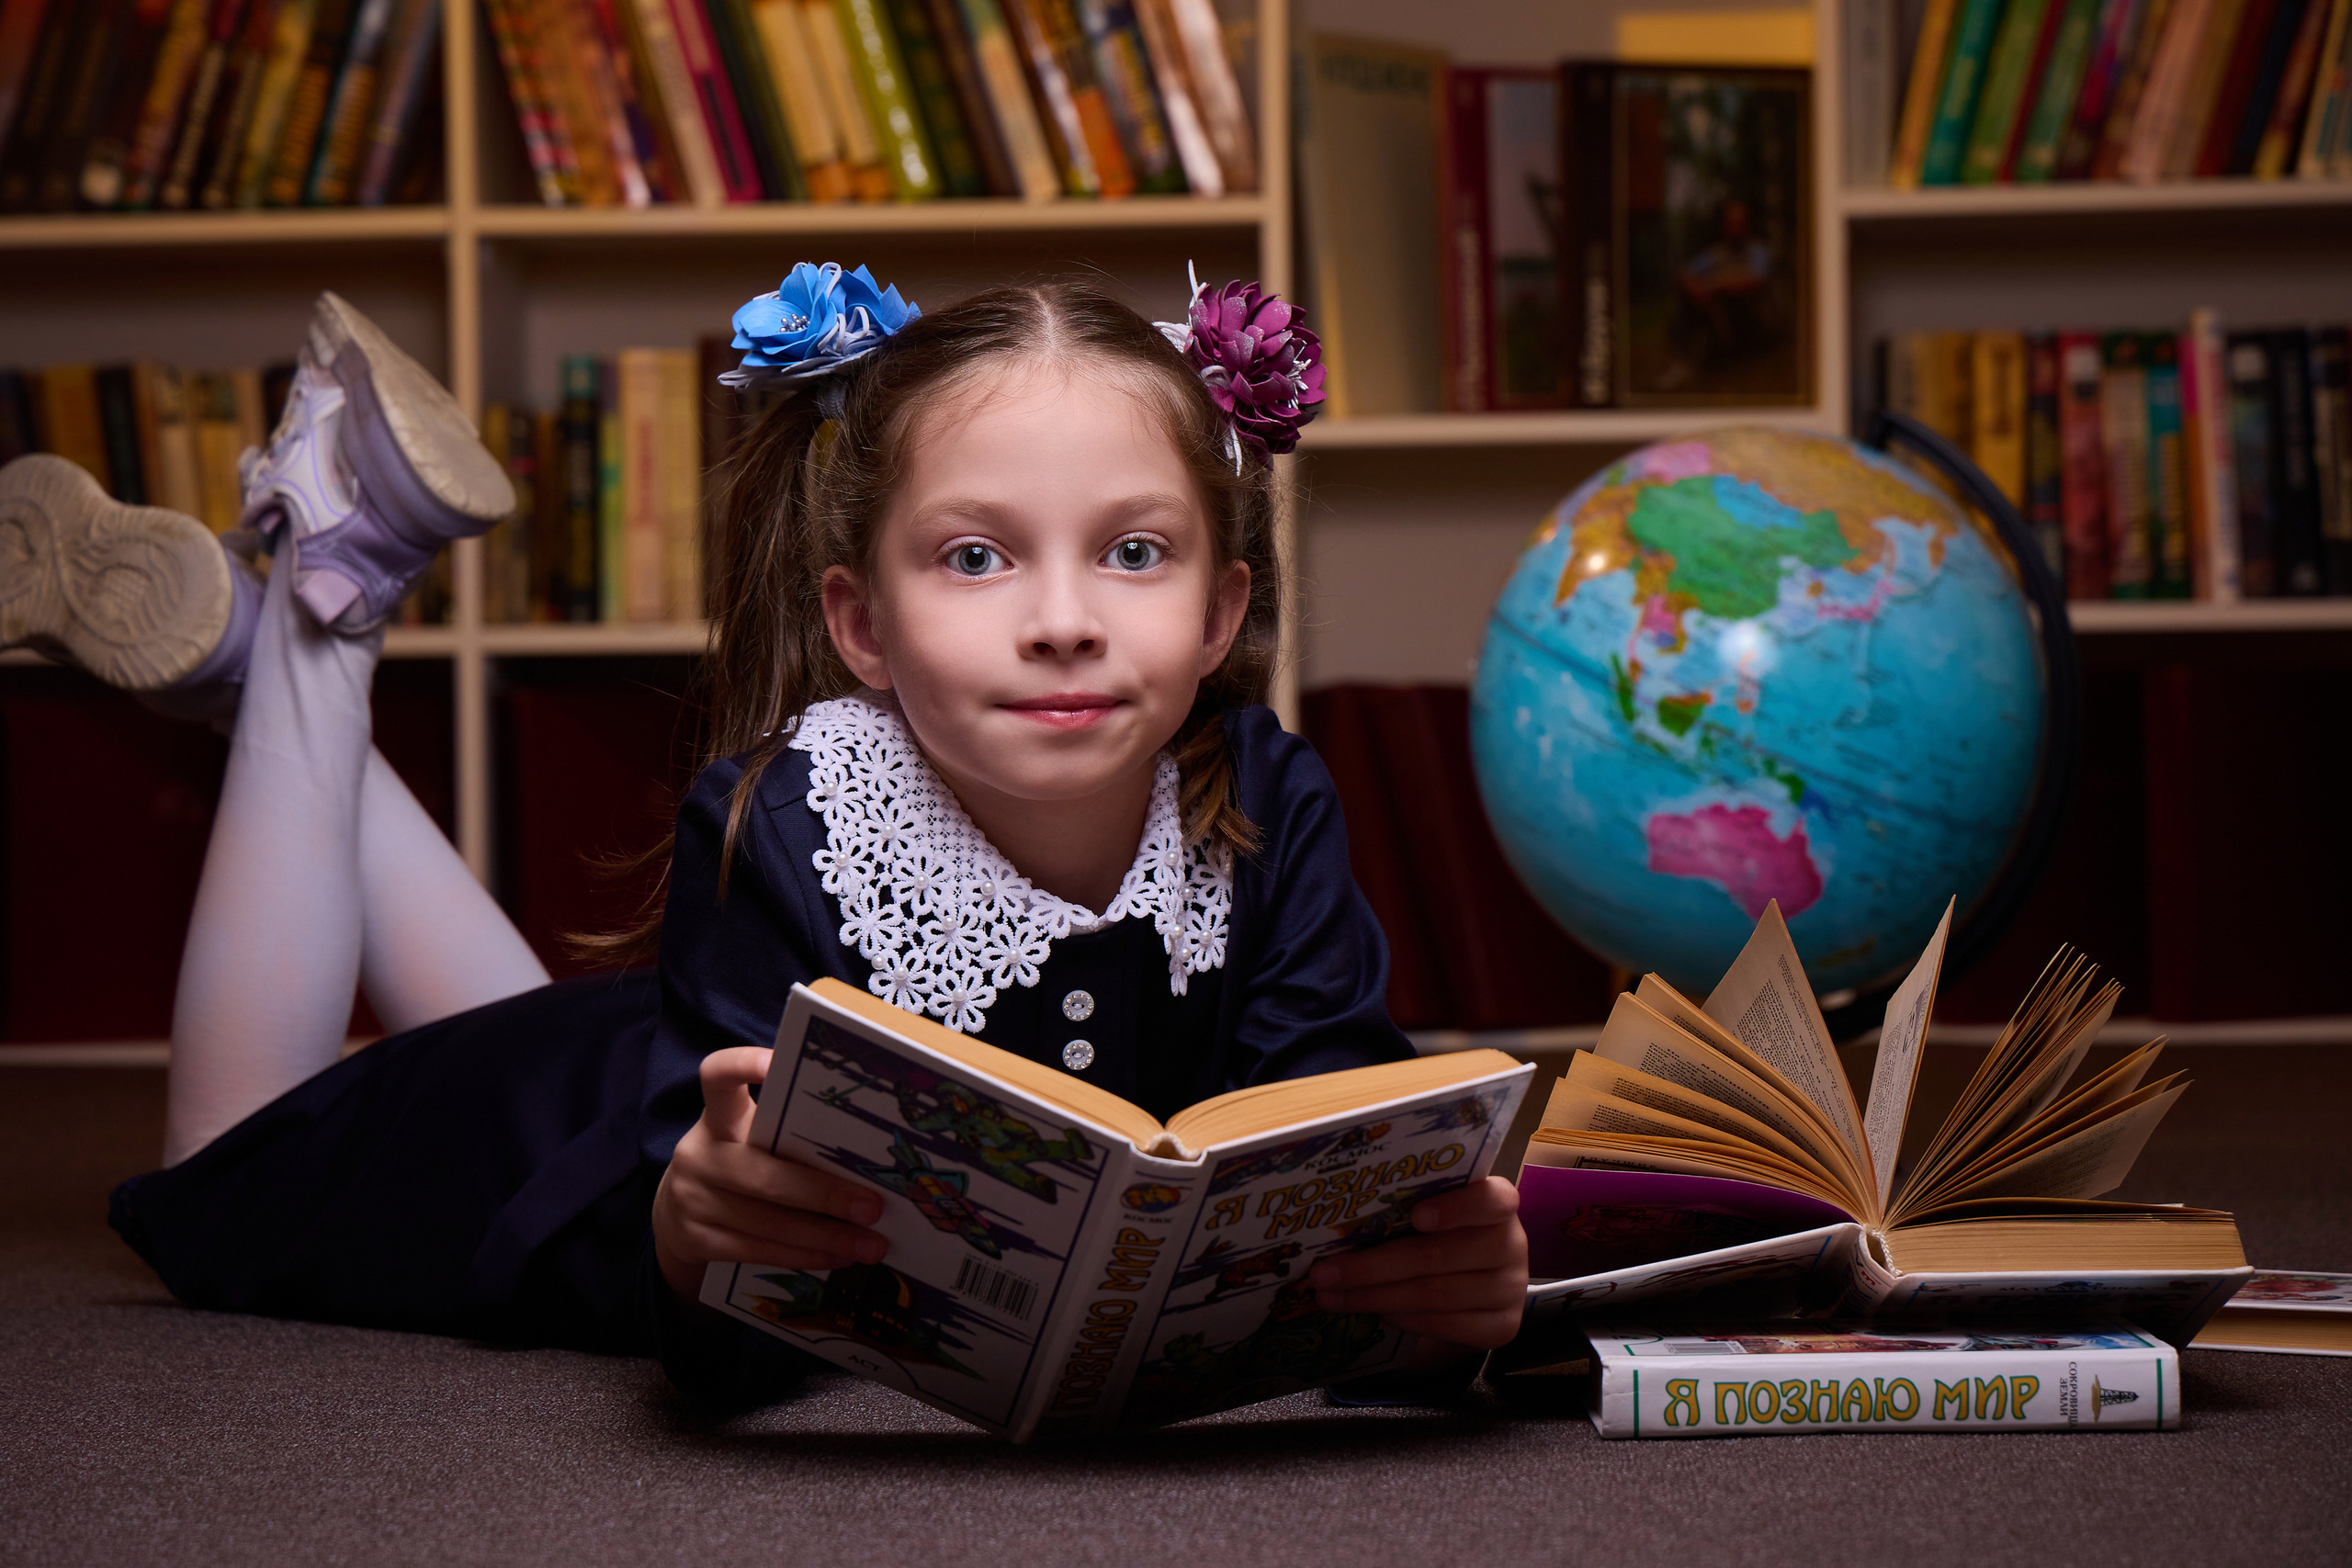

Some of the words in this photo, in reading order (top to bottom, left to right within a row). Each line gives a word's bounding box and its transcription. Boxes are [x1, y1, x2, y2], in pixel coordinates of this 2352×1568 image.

[1305, 1141, 1392, 1171] КОСМОС
[1205, 1192, 1250, 1231] Я
[1256, 1143, 1465, 1218] ПОЗНАЮ
[1263, 1190, 1380, 1240] МИР
[1049, 1298, 1138, 1413] ПОЗНАЮ
[1097, 1227, 1168, 1292] МИР
[847, 1353, 883, 1372] АСТ
[1663, 1378, 1701, 1427] Я
[1713, 1377, 1920, 1425] ПОЗНАЮ
[1932, 1374, 2041, 1421] МИР
[2059, 1377, 2069, 1416] ЗЕМЛИ
[2067, 1361, 2078, 1427] СОКРОВИЩА
